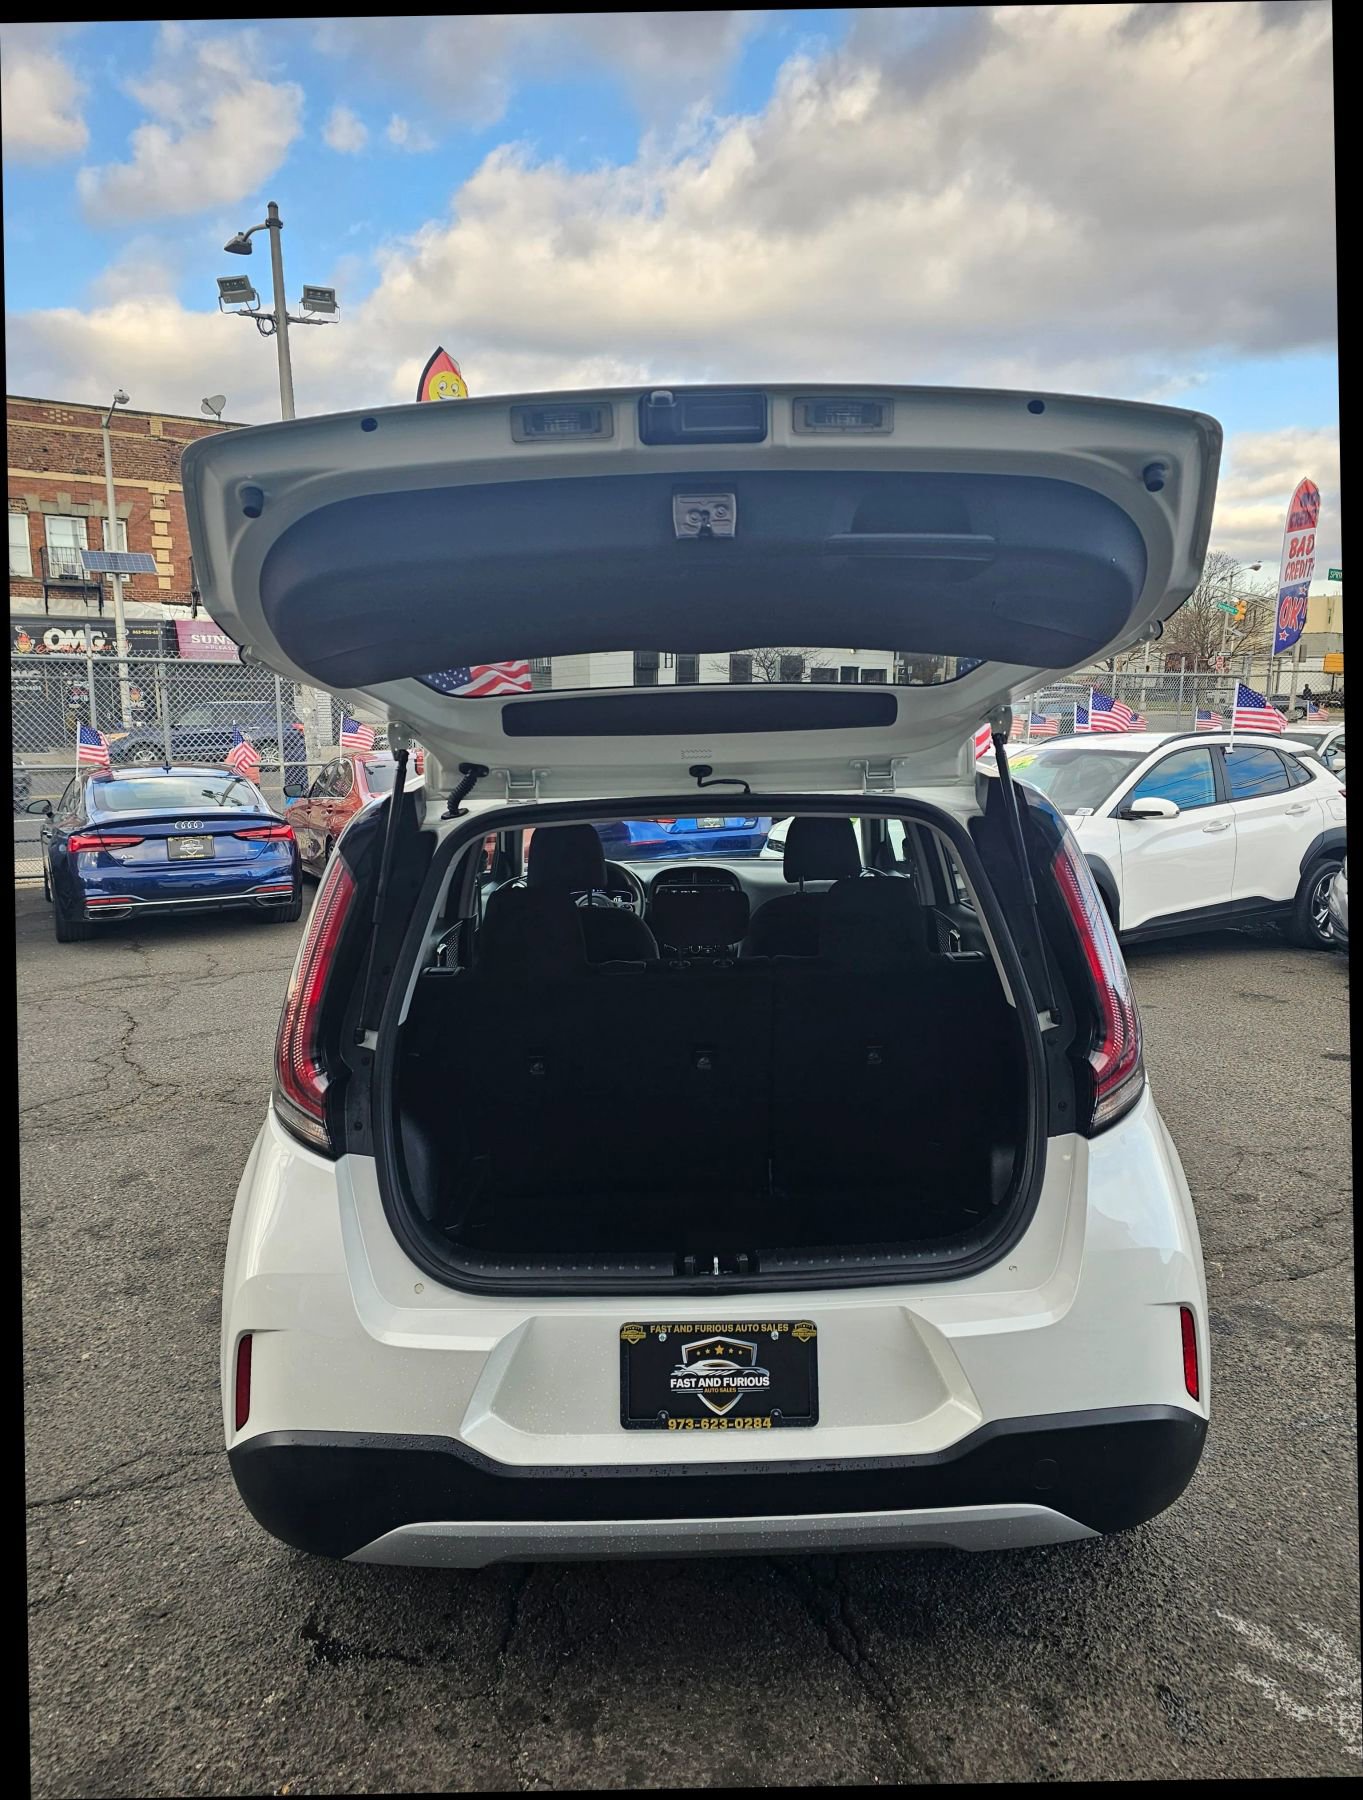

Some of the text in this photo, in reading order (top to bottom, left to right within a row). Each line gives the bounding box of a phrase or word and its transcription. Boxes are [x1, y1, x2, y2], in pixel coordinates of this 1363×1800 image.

[1289, 534, 1315, 559] BAD
[650, 1323, 789, 1333] FAST AND FURIOUS AUTO SALES
[670, 1376, 770, 1388] FAST AND FURIOUS
[668, 1417, 771, 1431] 973-623-0284
